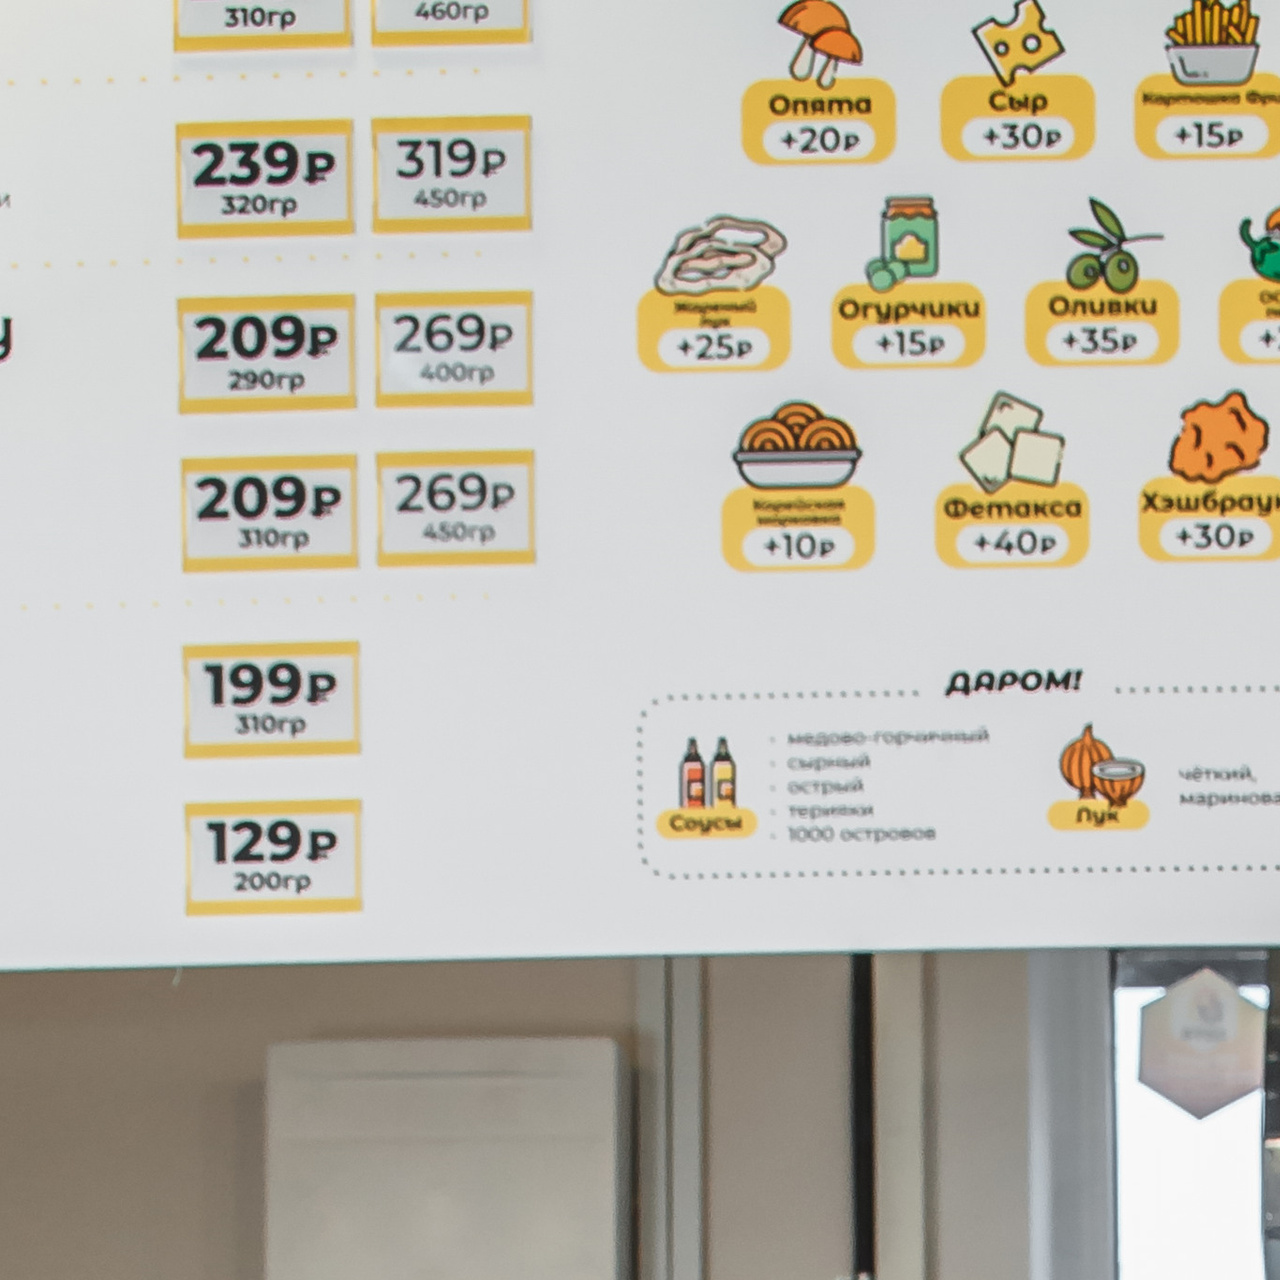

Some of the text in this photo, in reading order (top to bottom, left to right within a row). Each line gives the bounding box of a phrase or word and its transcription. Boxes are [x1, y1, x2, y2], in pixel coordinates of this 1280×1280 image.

[225, 6, 297, 31] 310гр
[414, 0, 490, 25] 460гр
[988, 87, 1049, 117] Сыр
[192, 140, 336, 188] 239₽
[221, 193, 298, 219] 320гр
[413, 187, 488, 212] 450гр
[838, 298, 981, 325] Огурчики
[1048, 295, 1158, 317] Оливки
[194, 314, 338, 361] 209₽
[229, 369, 306, 394] 290гр
[420, 361, 496, 386] 400гр
[195, 474, 342, 522] 209₽
[943, 493, 1083, 520] Фетакса
[238, 527, 310, 552] 310гр
[422, 521, 496, 544] 450гр
[203, 661, 337, 707] 199₽
[944, 669, 1084, 697] ДАРОМ!
[236, 713, 307, 738] 310гр
[668, 813, 743, 836] Соусы
[206, 819, 338, 865] 129₽
[234, 871, 312, 895] 200гр
